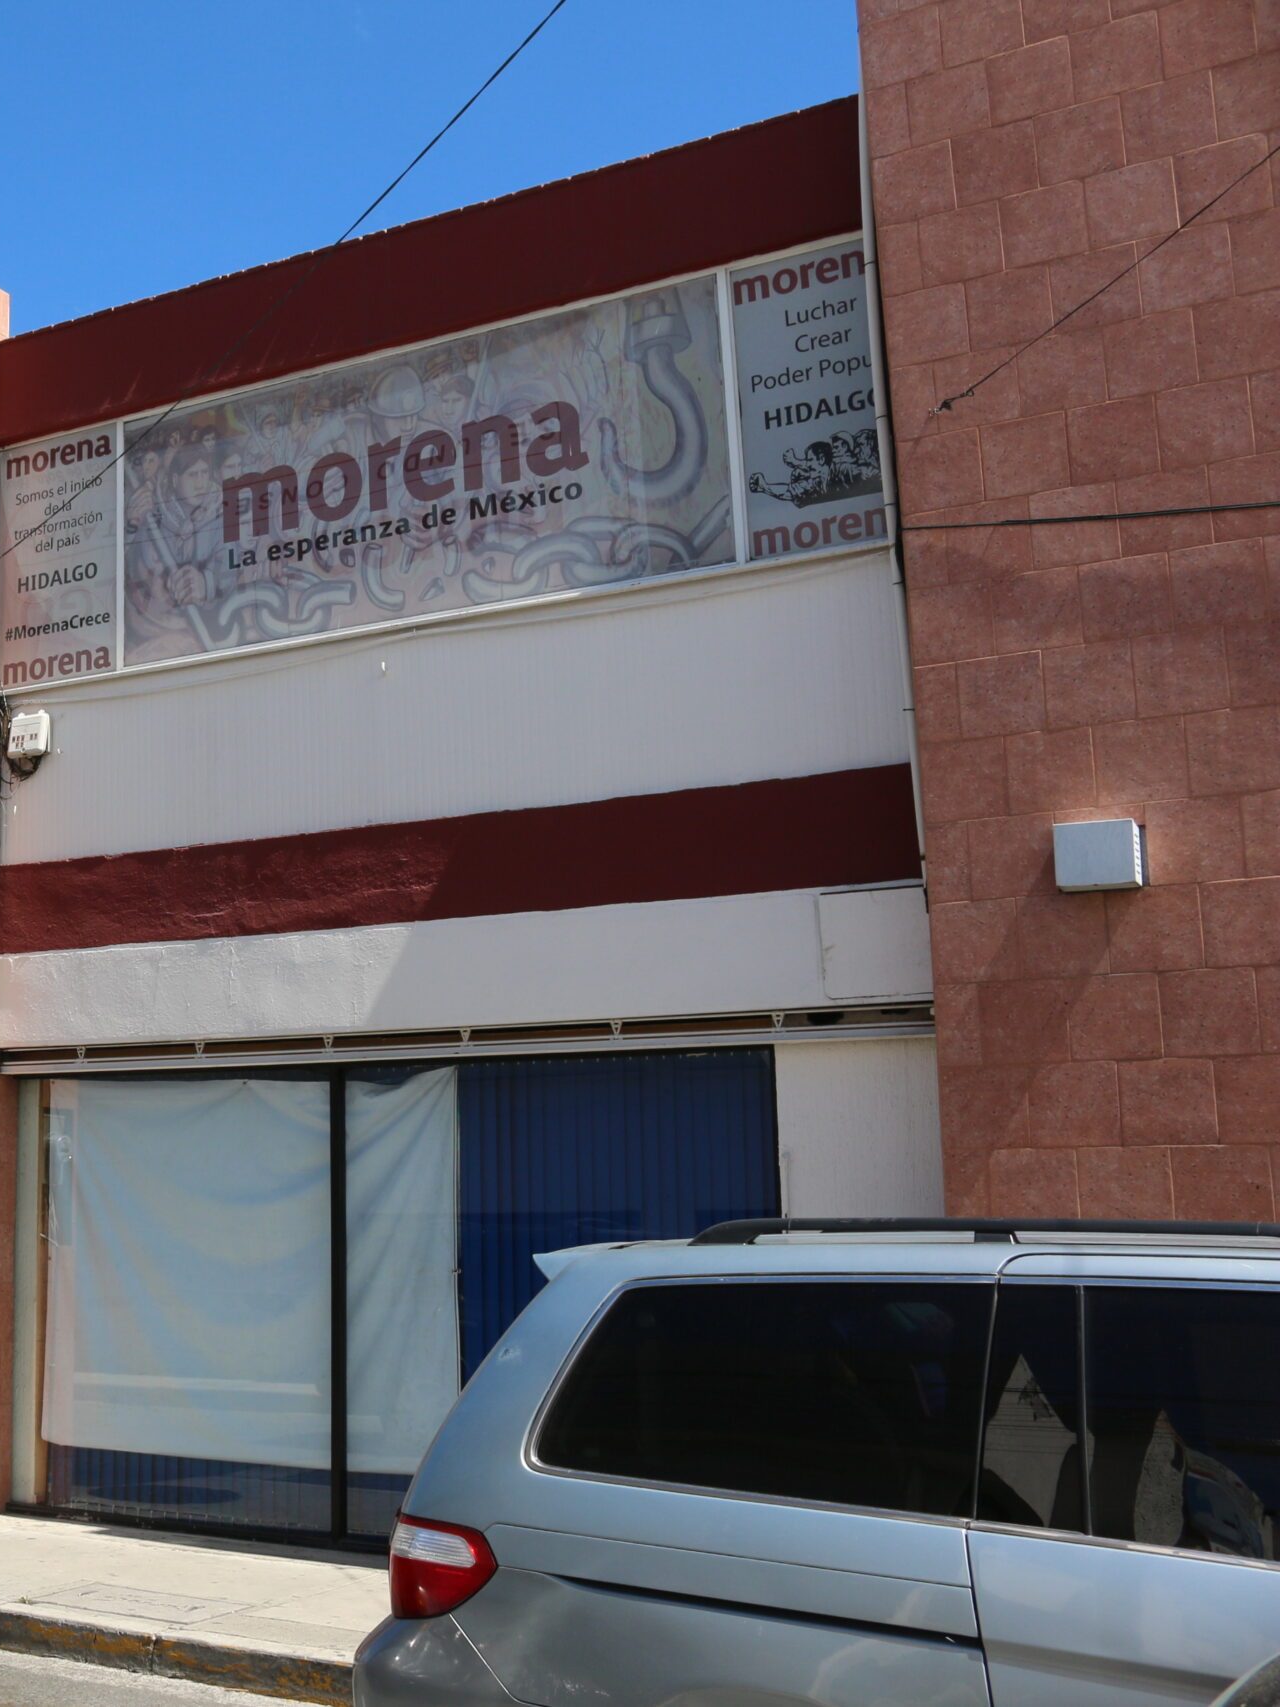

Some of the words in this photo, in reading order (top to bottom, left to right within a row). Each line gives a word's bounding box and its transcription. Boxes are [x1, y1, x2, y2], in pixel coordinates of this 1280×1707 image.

[732, 250, 865, 306] moren
[784, 297, 857, 327] Luchar
[795, 328, 852, 353] Crear
[751, 366, 813, 393] Poder
[819, 354, 872, 382] Popu
[6, 434, 112, 480] morena
[222, 401, 590, 544] morena
[15, 486, 54, 506] Somos
[57, 481, 68, 494] el
[70, 475, 103, 492] inicio
[44, 504, 57, 517] de
[61, 500, 72, 512] la
[14, 511, 103, 541] transformación
[228, 548, 258, 570] La
[267, 517, 412, 561] esperanza
[421, 503, 457, 530] de
[468, 481, 584, 521] México
[753, 507, 888, 557] moren
[35, 537, 54, 553] del
[56, 533, 81, 551] país
[17, 562, 98, 594] HIDALGO
[5, 611, 110, 642] #MorenaCrece
[3, 646, 111, 686] morena
